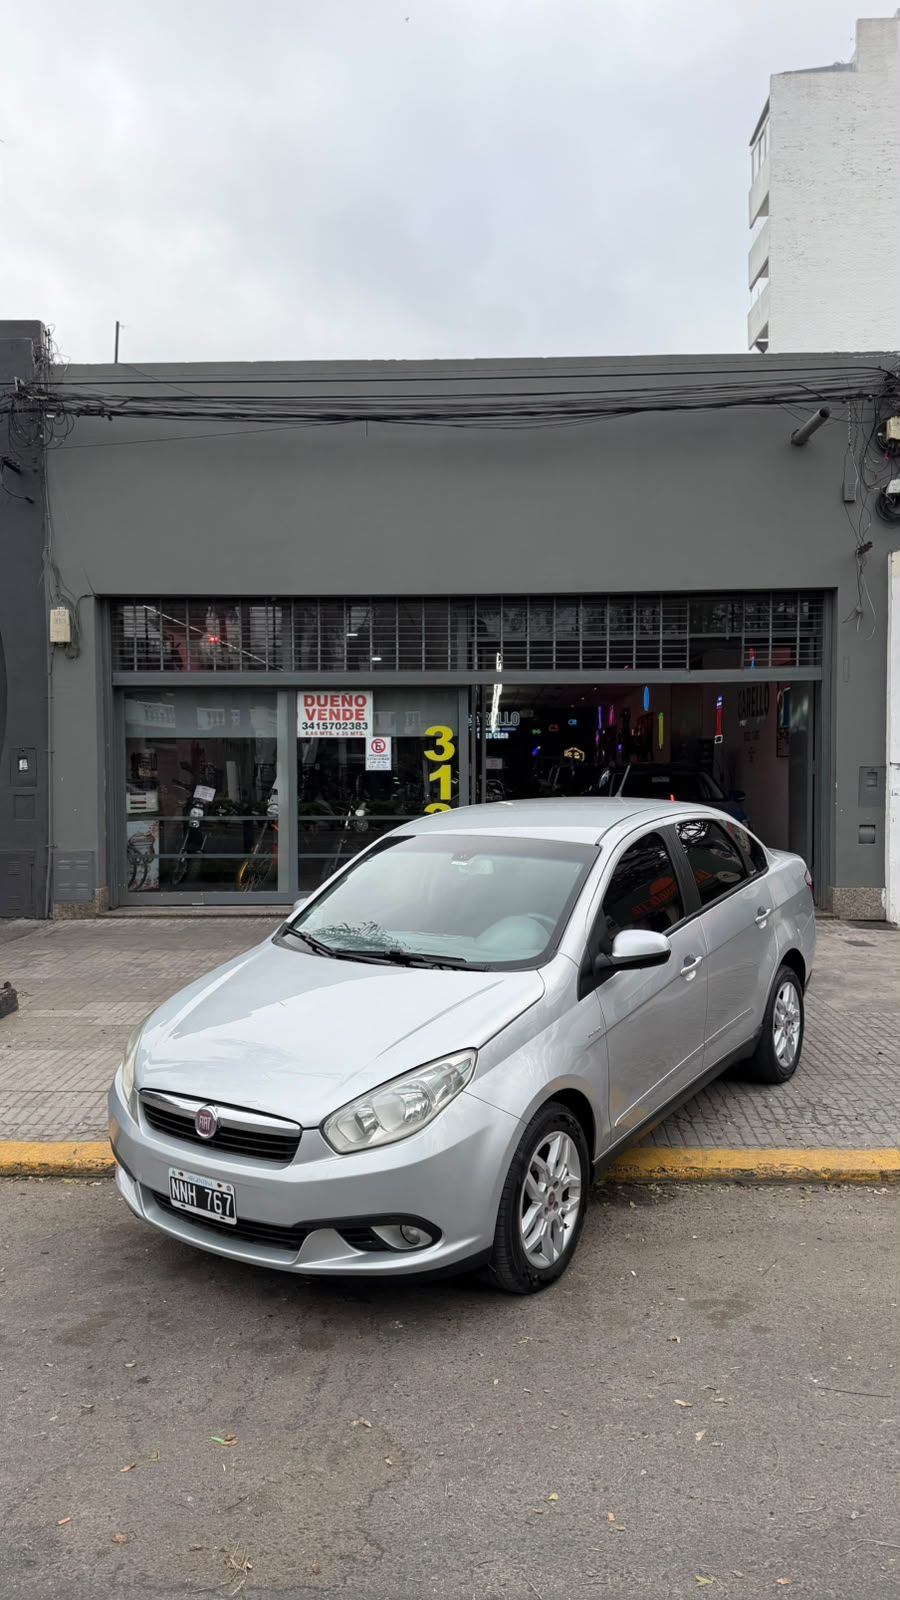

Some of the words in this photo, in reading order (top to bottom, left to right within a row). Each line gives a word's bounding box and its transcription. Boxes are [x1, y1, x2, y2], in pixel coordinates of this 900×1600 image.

[303, 692, 367, 708] DUEÑO
[305, 708, 365, 721] VENDE
[301, 721, 368, 730] 3415702383
[200, 1115, 211, 1131] FIAT
[171, 1178, 197, 1207] NNH
[204, 1189, 232, 1216] 767
